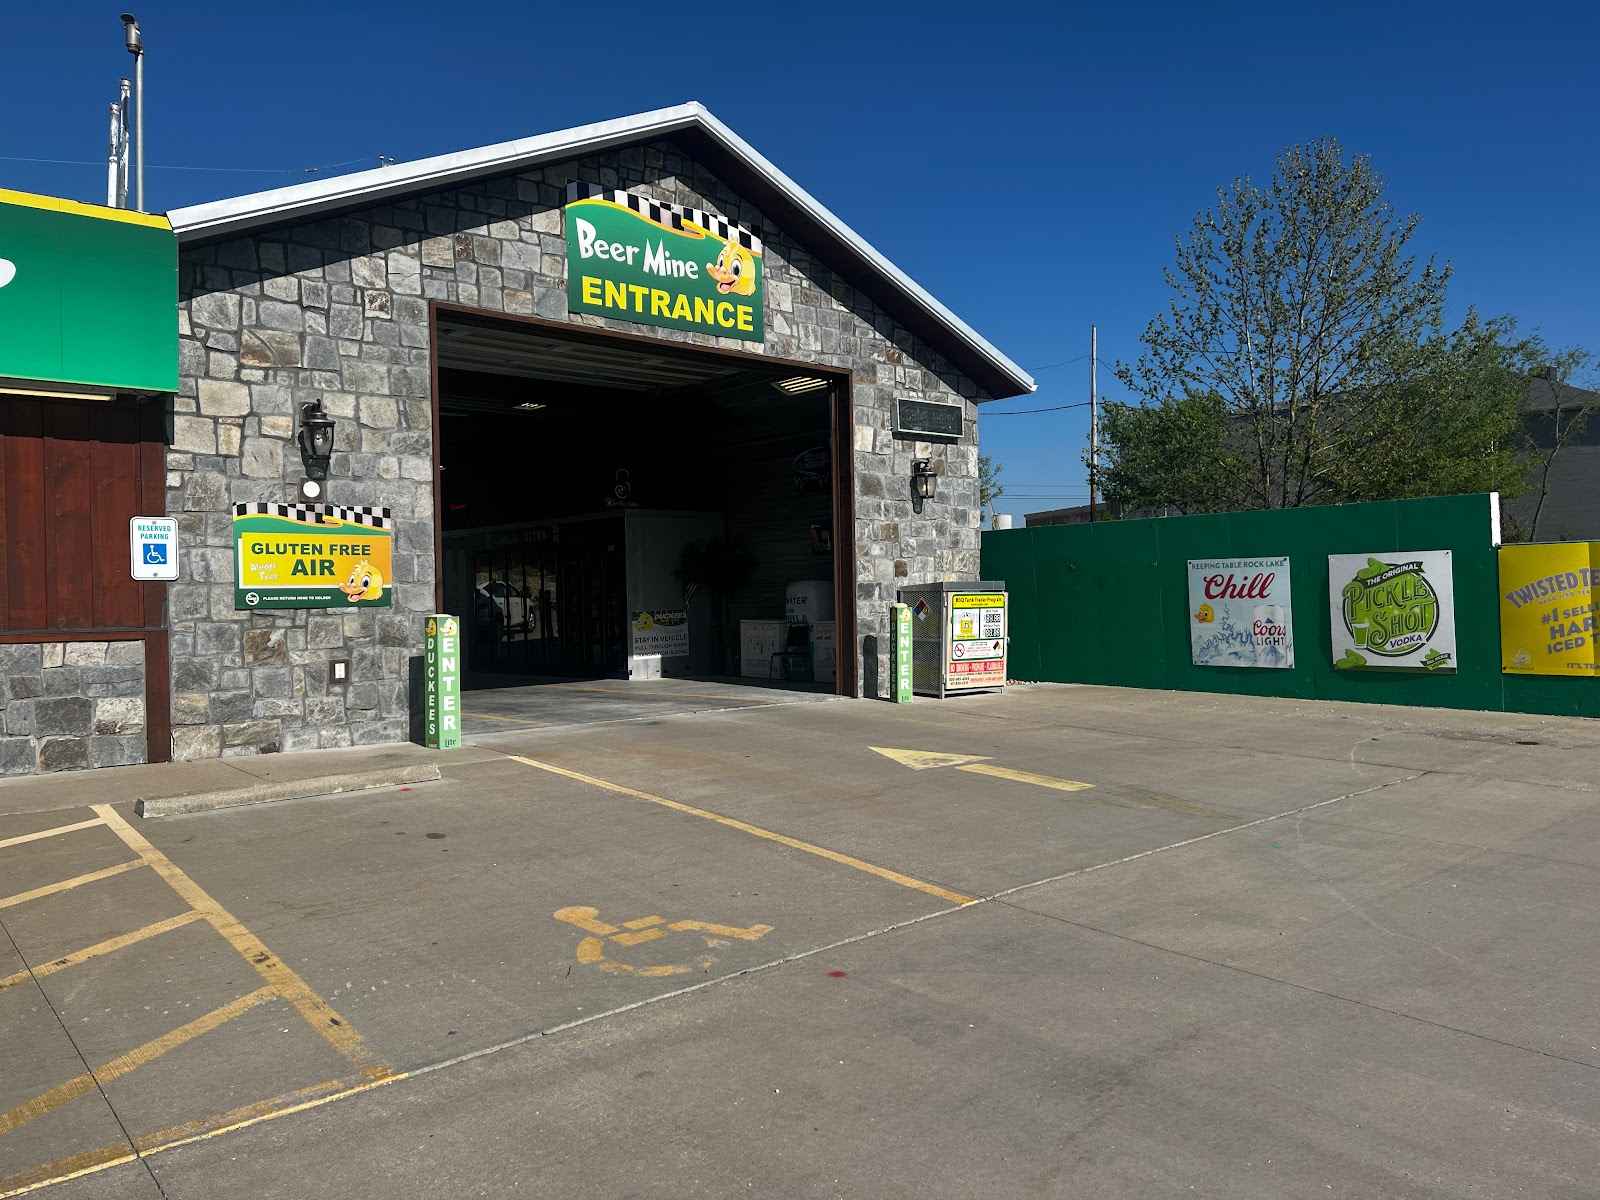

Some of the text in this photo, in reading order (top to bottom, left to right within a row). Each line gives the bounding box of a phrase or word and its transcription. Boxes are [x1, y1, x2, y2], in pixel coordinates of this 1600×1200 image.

[576, 217, 699, 280] Beer Mine
[581, 275, 754, 332] ENTRANCE
[138, 524, 172, 532] RESERVED
[251, 542, 371, 556] GLUTEN FREE
[291, 559, 336, 576] AIR
[1243, 560, 1264, 568] ROCK
[1265, 559, 1284, 567] LAKE
[1367, 563, 1419, 586] THE ORIGINAL
[1203, 572, 1275, 599] Chill
[1343, 574, 1429, 621] PICKLE
[1505, 571, 1578, 608] TWISTED
[1253, 619, 1286, 637] Coors
[1369, 603, 1427, 648] SHOT
[1256, 636, 1285, 646] LIGHT
[1389, 634, 1423, 648] VODKA
[1548, 637, 1585, 654] ICED
[900, 623, 910, 690] ENTER
[427, 638, 436, 735] DUCKEES
[442, 637, 456, 731] ENTER
